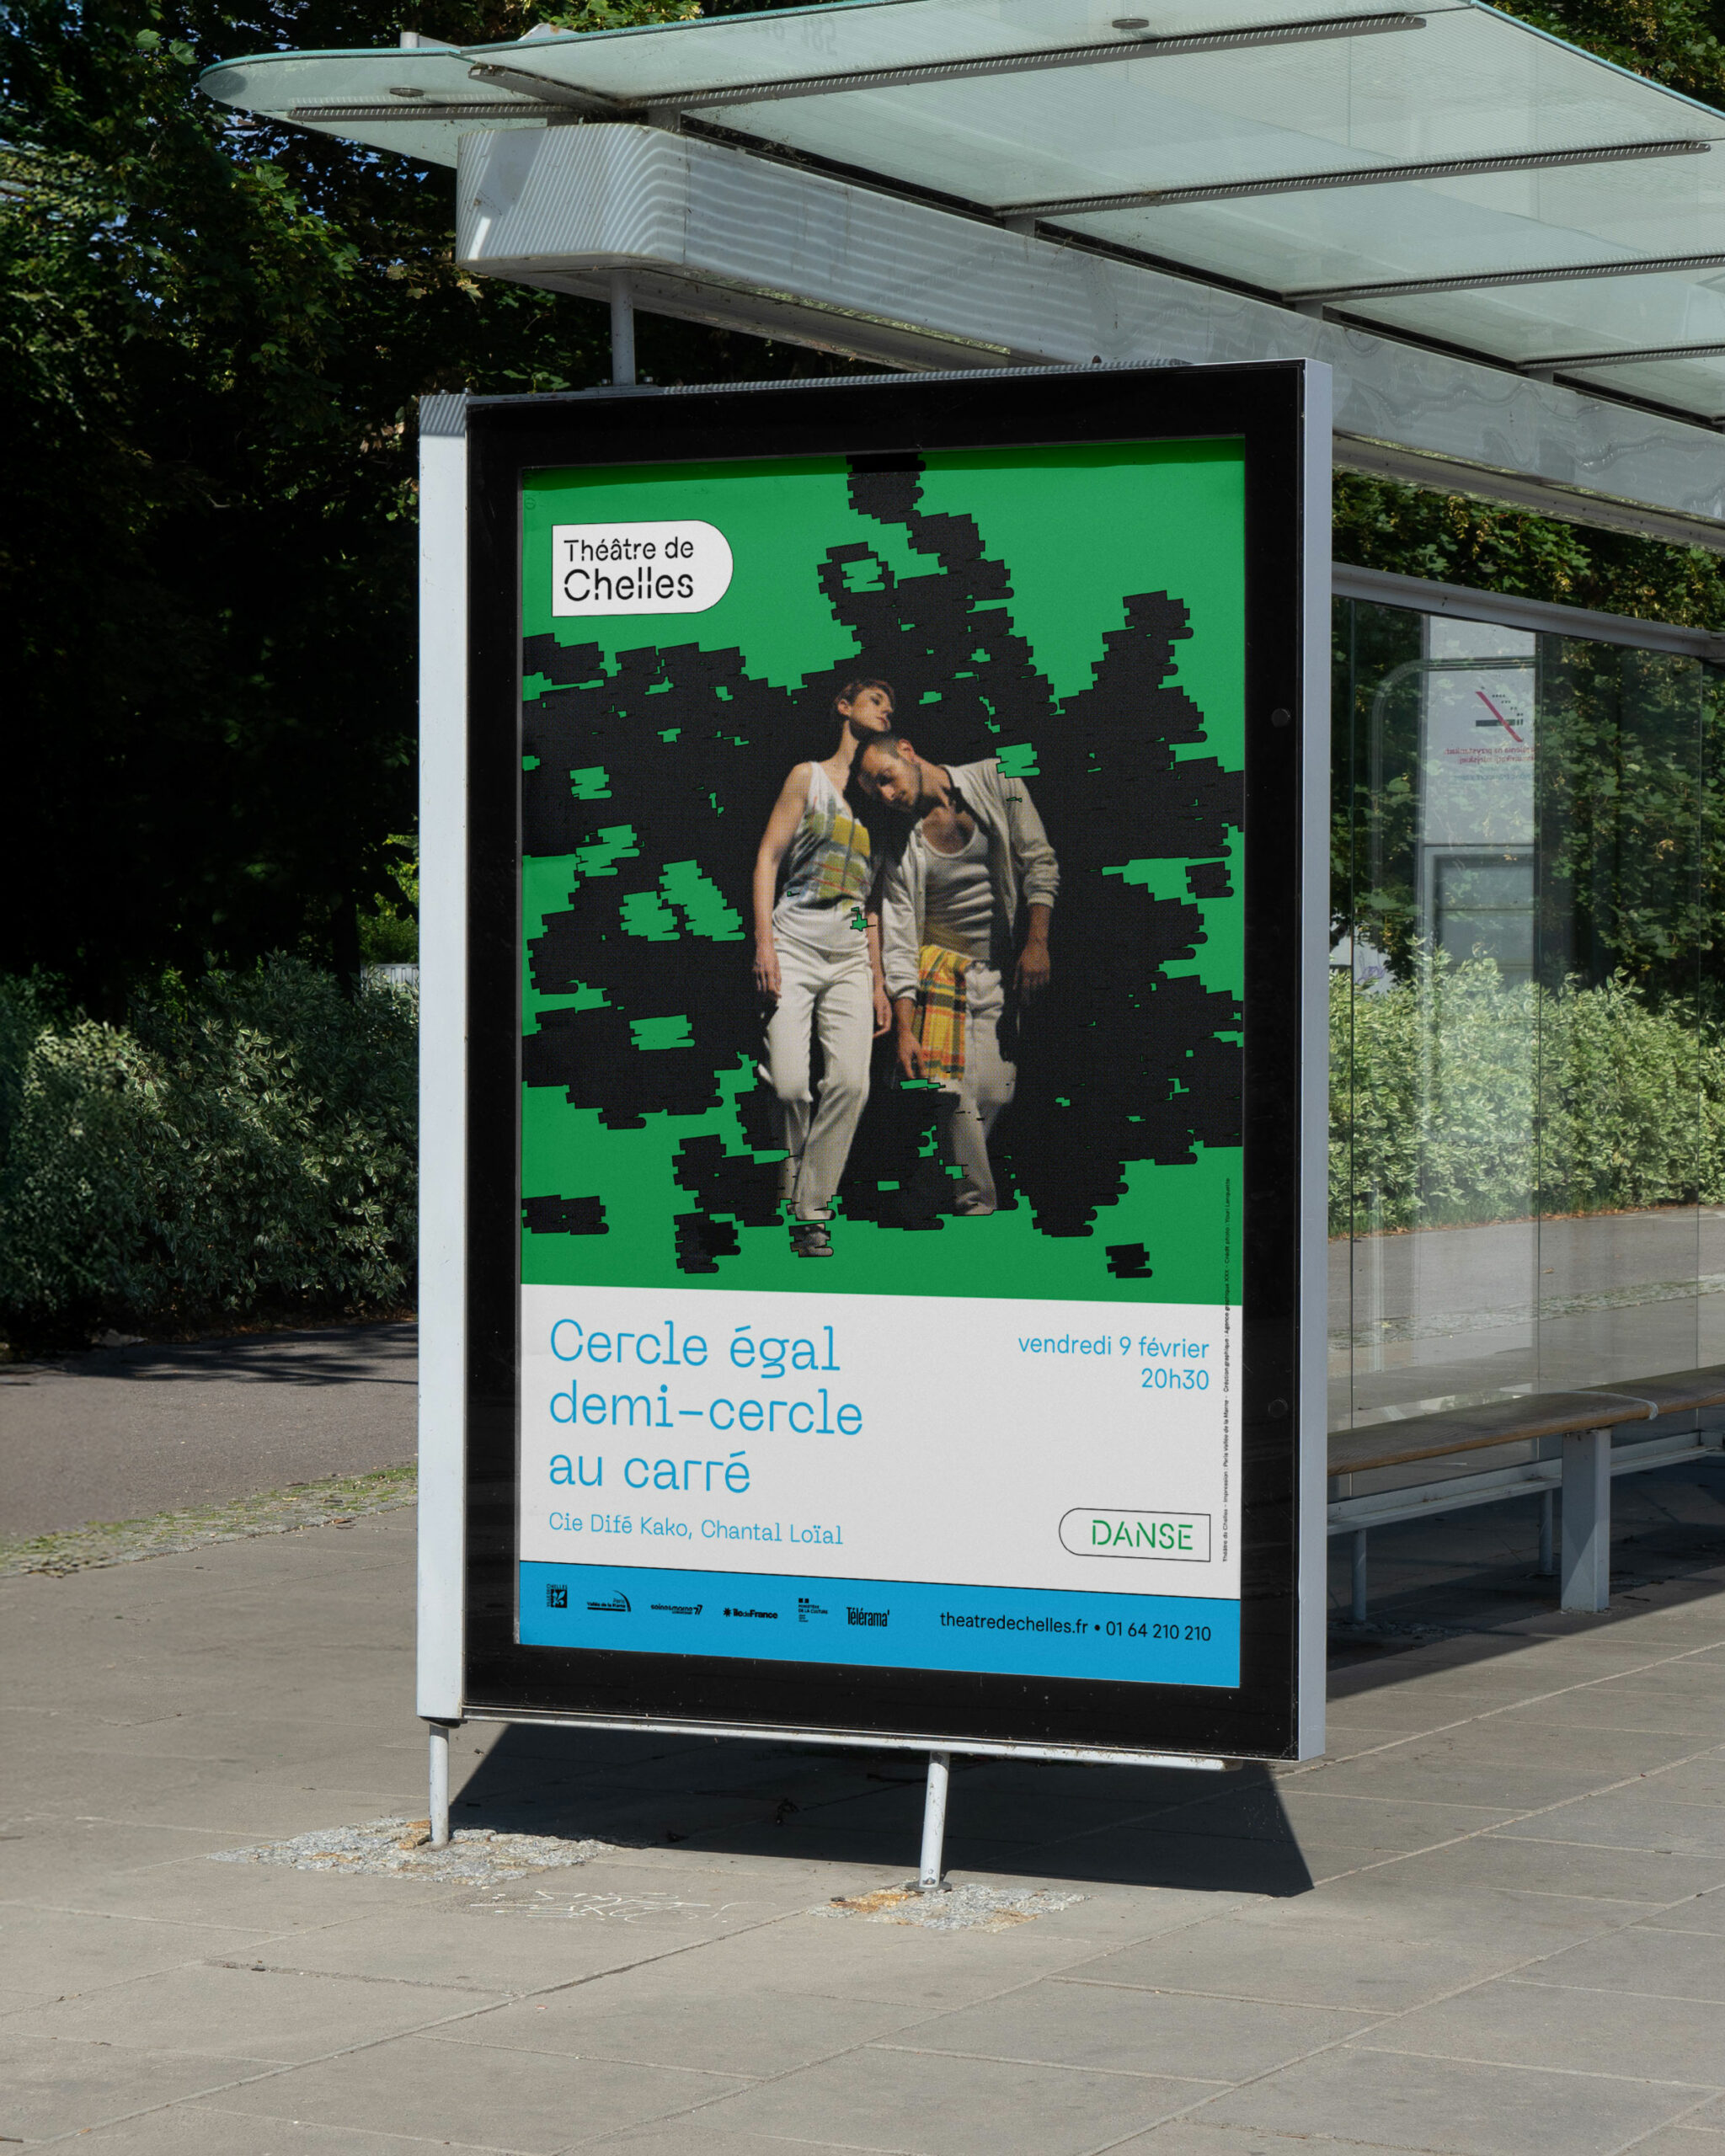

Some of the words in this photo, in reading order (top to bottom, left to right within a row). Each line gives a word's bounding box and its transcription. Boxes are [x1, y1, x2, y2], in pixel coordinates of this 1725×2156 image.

[563, 538, 656, 563] Théâtre
[665, 536, 694, 559] de
[563, 566, 694, 602] Chelles
[550, 1318, 708, 1367] Cercle
[729, 1324, 841, 1380] égal
[1017, 1333, 1112, 1356] vendredi
[1119, 1335, 1132, 1357] 9
[1138, 1335, 1210, 1359] février
[1140, 1367, 1210, 1391] 20h30
[548, 1453, 603, 1487] au
[623, 1449, 750, 1494] carré
[548, 1511, 584, 1532] Cie
[590, 1513, 633, 1535] Difé
[640, 1515, 692, 1540] Kako,
[701, 1518, 782, 1542] Chantal
[790, 1523, 843, 1545] Loïal
[1092, 1519, 1194, 1550] DANSE
[939, 1611, 1089, 1635] theatredechelles.fr
[1105, 1620, 1123, 1637] 01
[1127, 1622, 1148, 1638] 64
[1152, 1623, 1180, 1640] 210
[1183, 1625, 1212, 1642] 210
